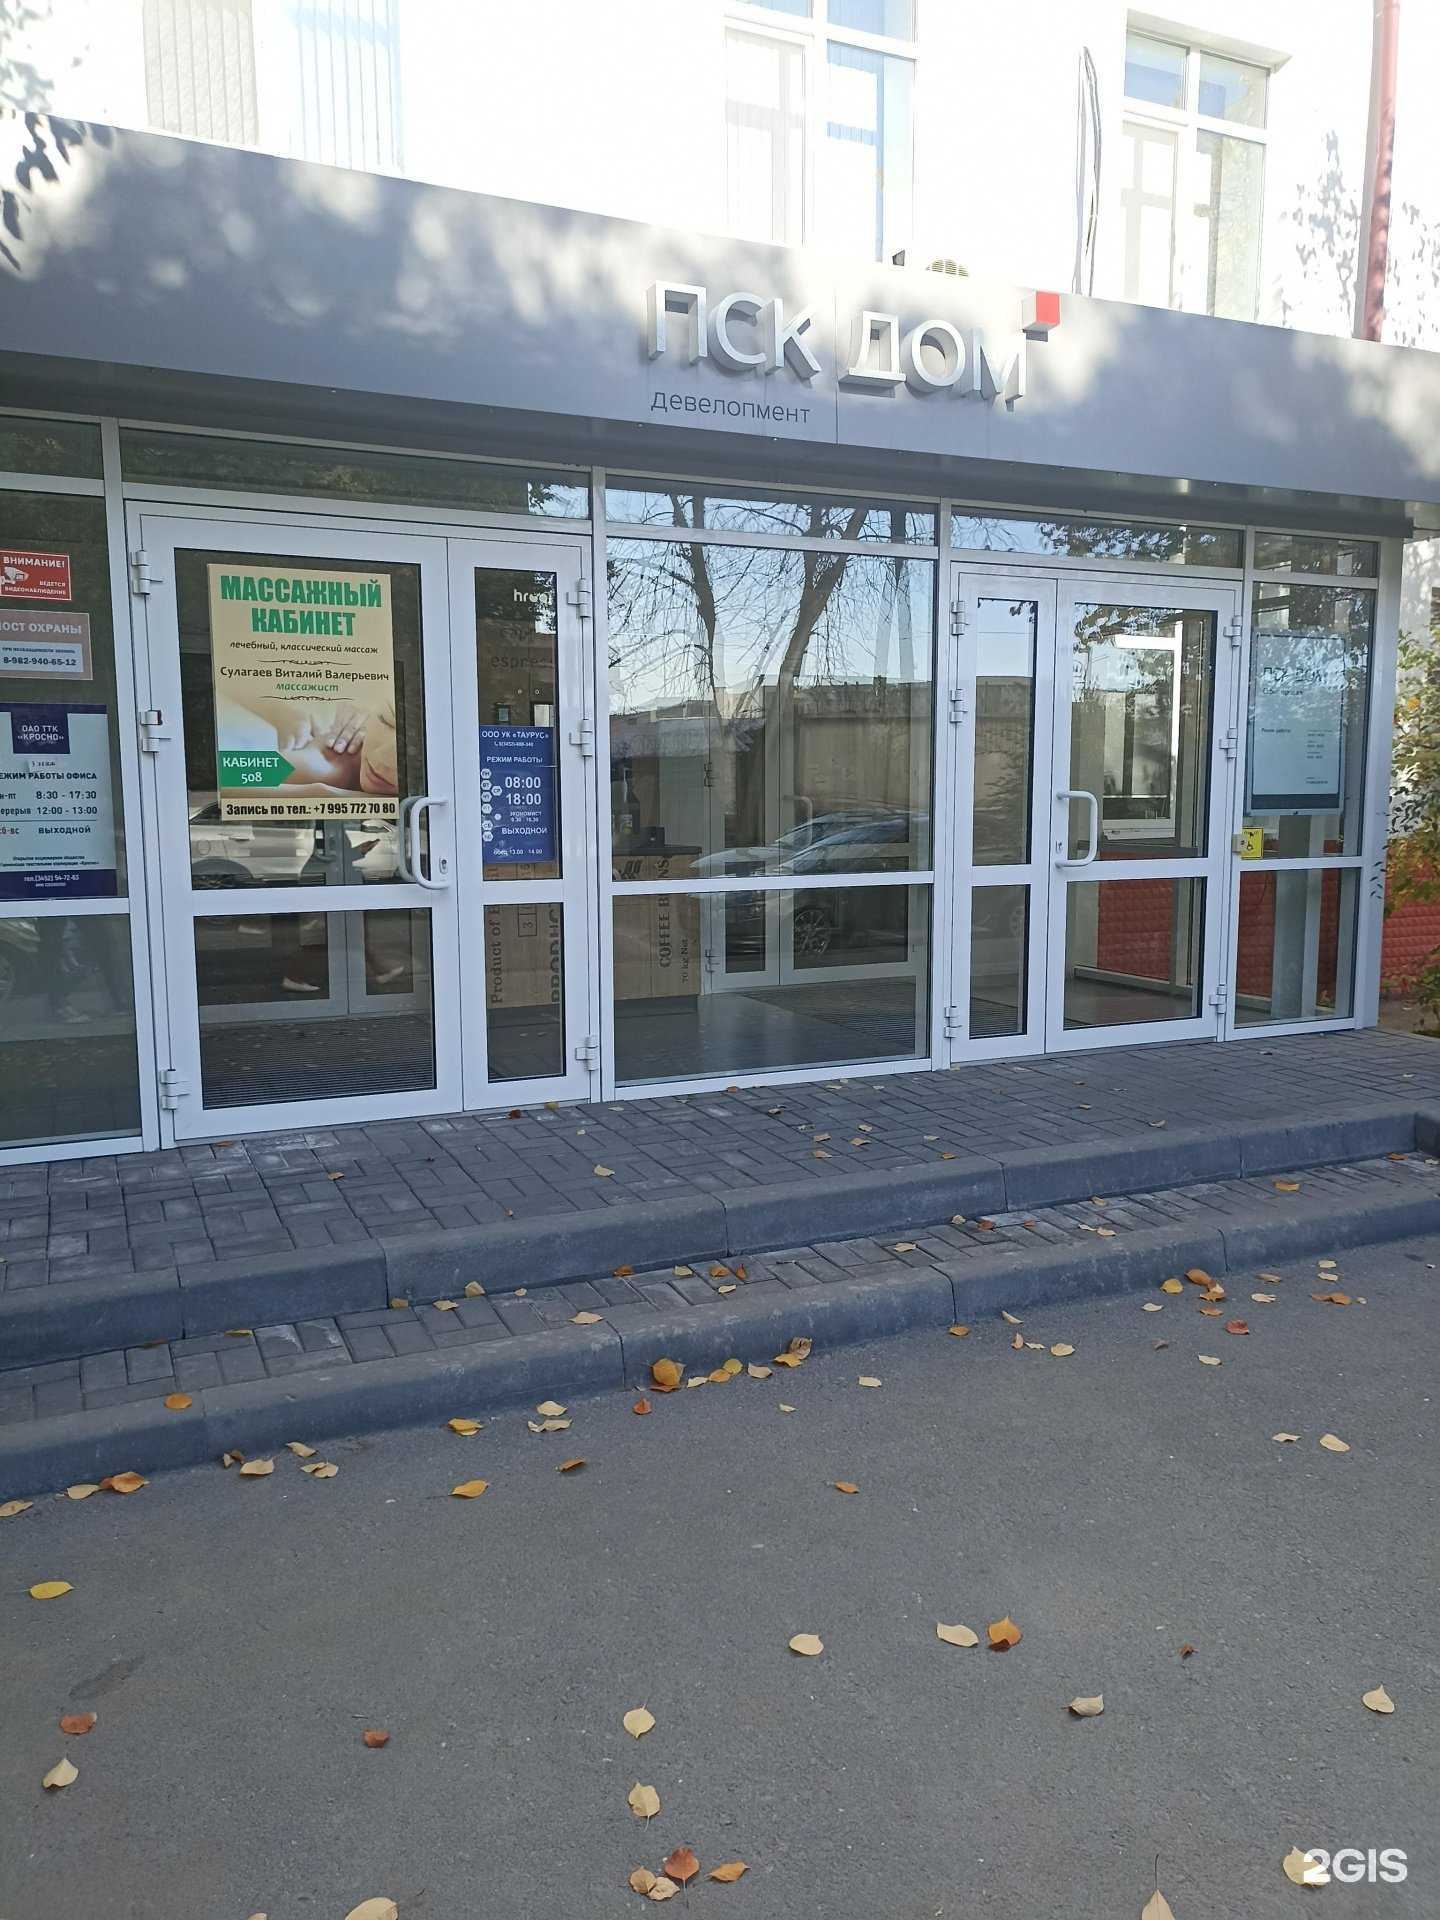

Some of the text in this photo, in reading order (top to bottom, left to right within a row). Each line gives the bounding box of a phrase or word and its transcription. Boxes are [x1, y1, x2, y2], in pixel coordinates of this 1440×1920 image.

[647, 281, 1027, 401] ПСК ДОМ
[650, 391, 811, 423] девелопмент
[3, 556, 65, 568] ВНИМАНИЕ!
[4, 586, 66, 595] ВИДЕОНАБЛЮДЕНИЕ
[220, 575, 382, 608] МАССАЖНЫЙ
[0, 621, 82, 634] ОСТ ОХРАНЫ
[251, 608, 356, 636] КАБИНЕТ
[230, 641, 378, 654] лечебный, классический массаж
[220, 666, 389, 681] Сулагаев Виталий Валерьевич
[275, 683, 339, 692] массажист
[481, 730, 500, 738] ООО
[222, 757, 279, 768] КАБИНЕТ
[28, 772, 65, 780] РАБОТЫ
[66, 772, 98, 780] ОФИСА
[241, 771, 263, 784] 508
[505, 776, 541, 788] 08:00
[36, 791, 58, 799] 8:30
[69, 791, 97, 799] 17:30
[505, 793, 542, 805] 18:00
[37, 806, 63, 815] 12:00
[72, 806, 98, 815] 13:00
[226, 803, 396, 815] Запись по тел.: +7 995 772 70 80
[658, 912, 673, 968] COFFEE
[490, 942, 503, 1004] Product
